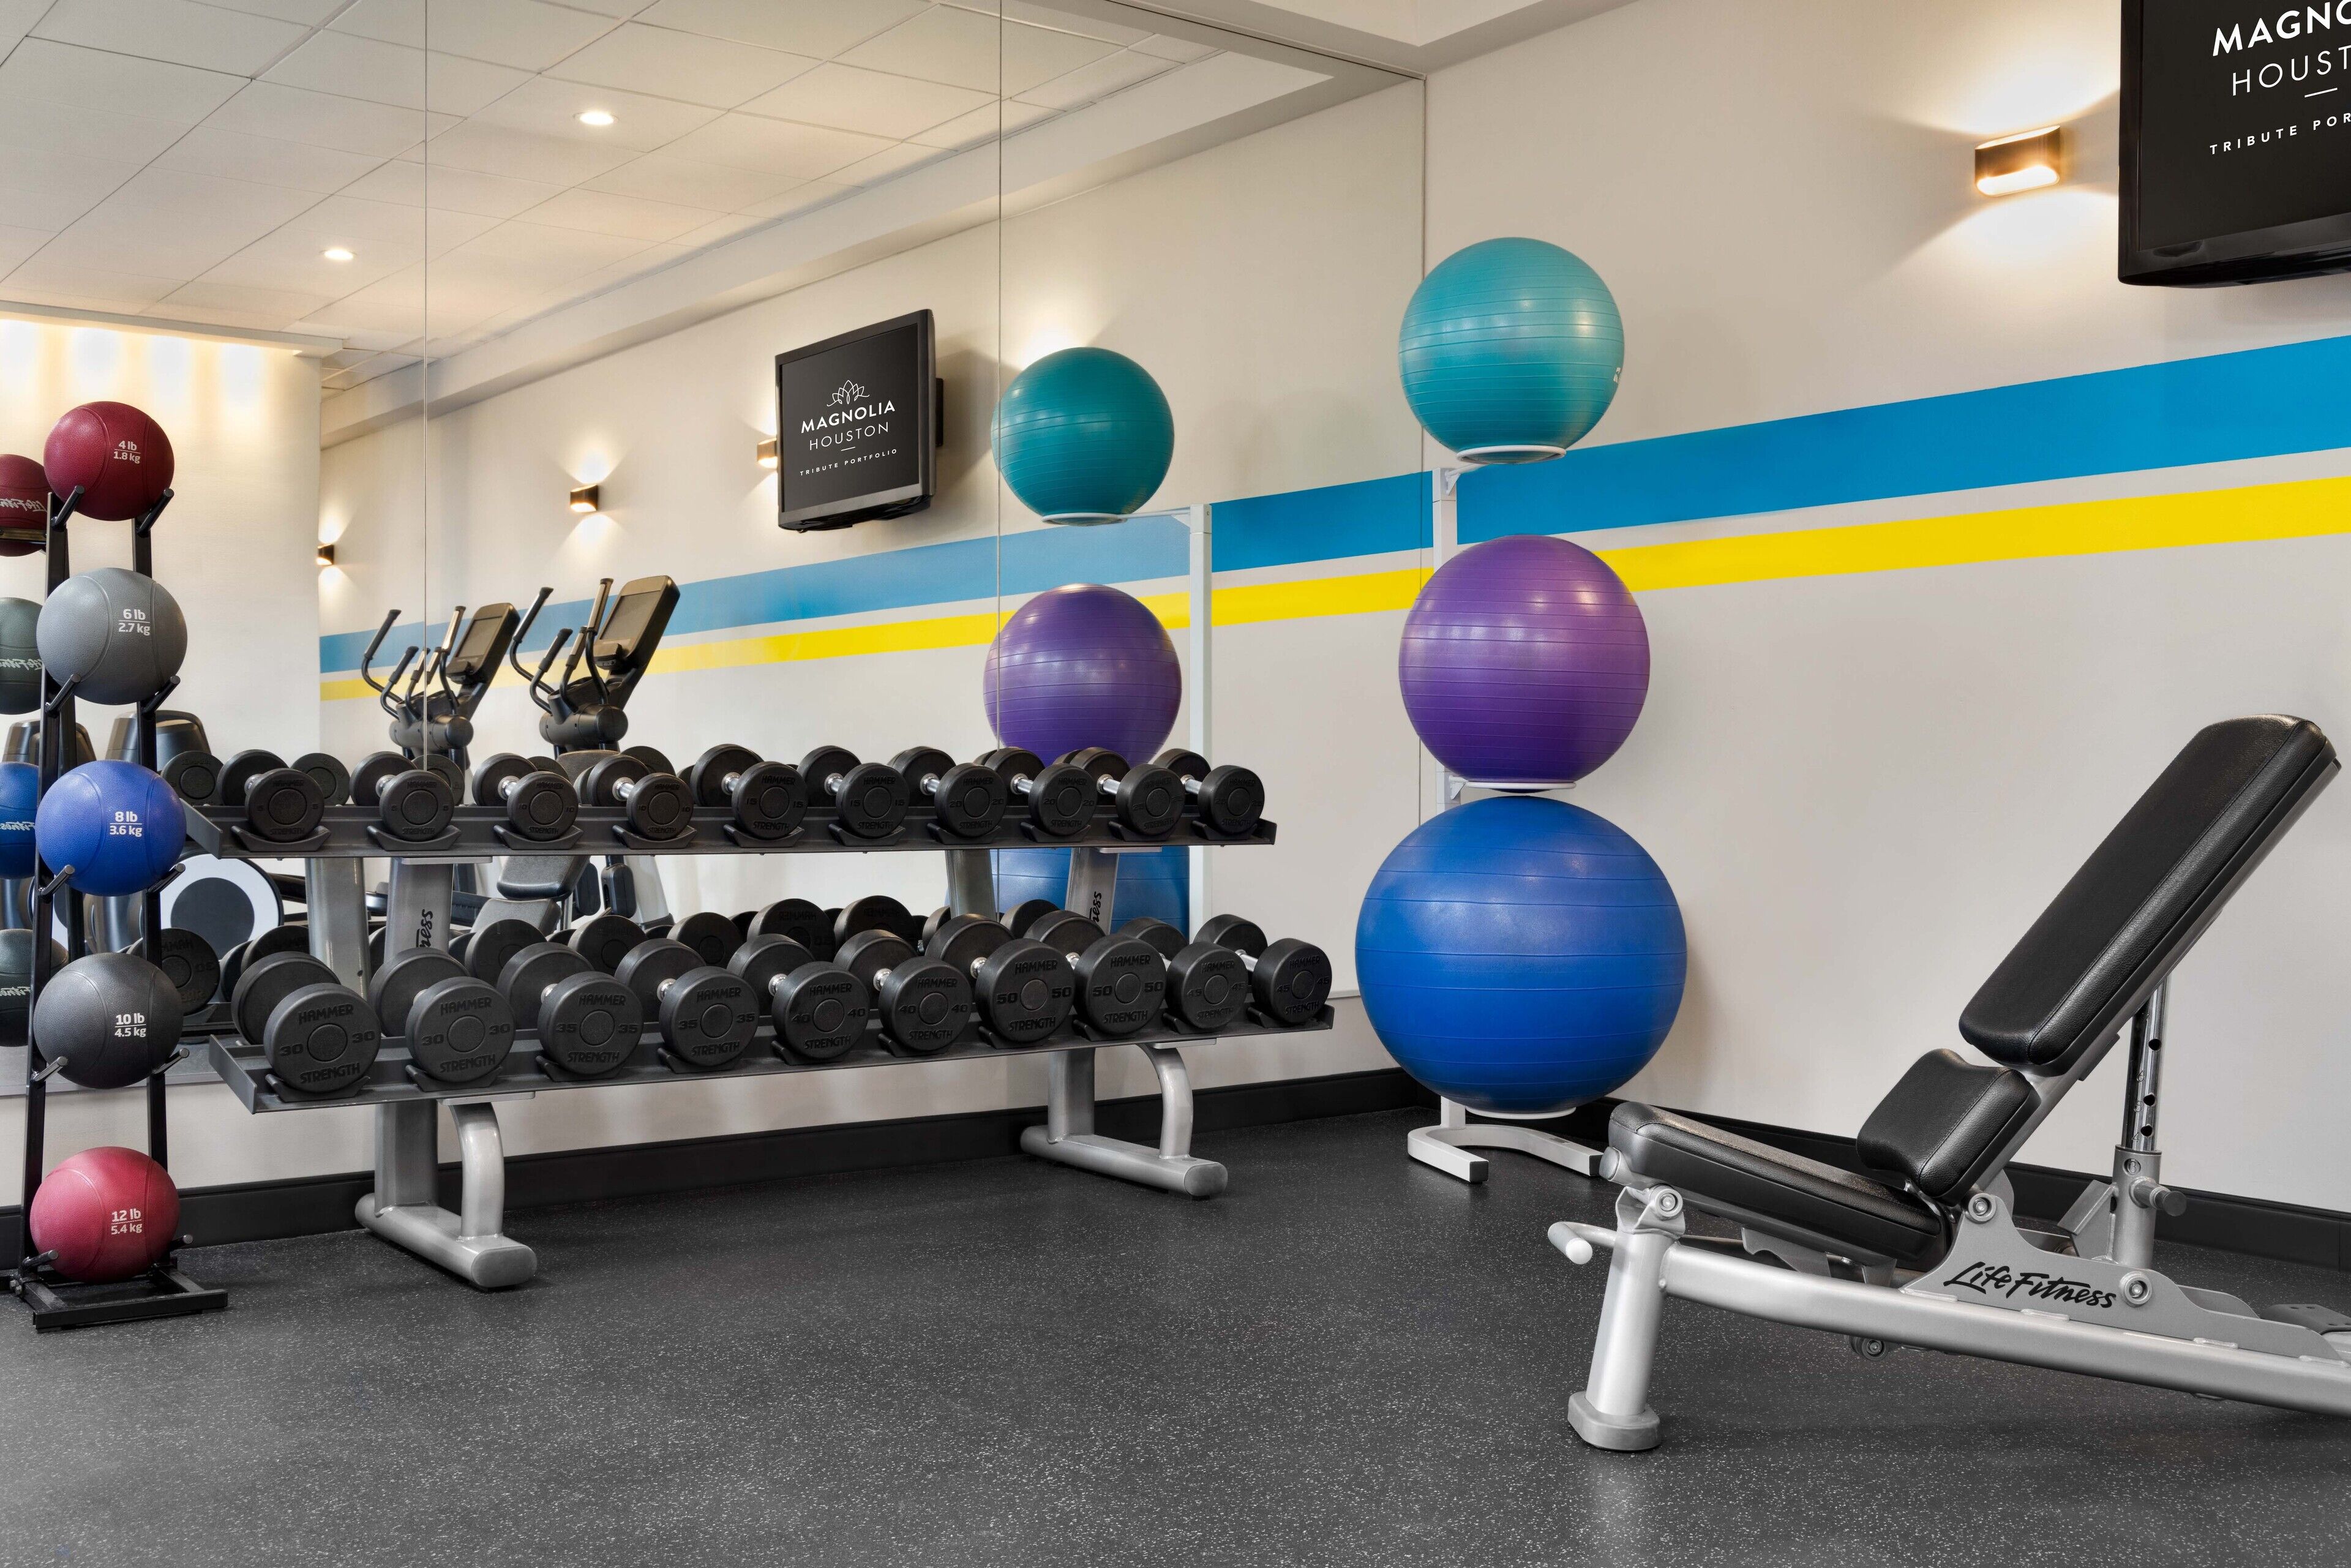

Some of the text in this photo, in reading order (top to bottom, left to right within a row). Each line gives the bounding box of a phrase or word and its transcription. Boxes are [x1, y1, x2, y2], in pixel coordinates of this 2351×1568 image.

[2233, 45, 2351, 96] HOUST
[2210, 112, 2351, 155] TRIBUTE POR
[801, 400, 896, 434] MAGNOLIA
[809, 421, 889, 451] HOUSTON
[118, 440, 137, 451] 4 lb
[113, 451, 141, 464] 1.8 kg
[800, 449, 898, 476] TRIBUTE PORTFOLIO
[123, 609, 146, 620] 6 lb
[118, 623, 151, 636] 2.7 kg
[762, 775, 796, 786] HAMMER
[115, 811, 138, 822] 8 lb
[109, 825, 143, 838] 3.6 kg
[752, 820, 790, 830] STRENGTH
[1089, 891, 1102, 923] ness
[416, 909, 433, 948] ness
[1015, 959, 1059, 975] HAMMER
[1110, 954, 1152, 968] HAMMER
[1201, 959, 1235, 974] HAMMER
[1289, 956, 1321, 972] HAMMER
[809, 983, 852, 996] HAMMER
[917, 978, 958, 989] HAMMER
[1092, 981, 1164, 996] 50 50
[1277, 977, 1329, 993] 45 45
[579, 994, 627, 1007] HAMMER
[696, 986, 742, 1002] HAMMER
[996, 986, 1073, 1004] 50 50
[440, 996, 492, 1016] HAMMER
[898, 1003, 969, 1015] 40 40
[1196, 1007, 1234, 1020] STRENGTH
[1284, 1001, 1319, 1015] STRENGTH
[116, 1013, 145, 1026] 10 lb
[298, 1003, 354, 1026] HAMMER
[678, 1012, 756, 1029] 35 35
[791, 1008, 866, 1024] 40 40
[1103, 1010, 1149, 1024] STRENGTH
[555, 1023, 639, 1035] 35 35
[1008, 1016, 1057, 1032] STRENGTH
[114, 1027, 146, 1039] 4.5 kg
[421, 1023, 511, 1046] 30 30
[909, 1030, 953, 1041] STRENGTH
[279, 1030, 375, 1056] 30 30
[691, 1041, 740, 1057] STRENGTH
[804, 1035, 852, 1050] STRENGTH
[439, 1054, 497, 1074] STRENGTH
[567, 1051, 620, 1063] STRENGTH
[298, 1062, 361, 1084] STRENGTH
[2137, 1070, 2145, 1082] 6
[111, 1209, 141, 1222] 12 lb
[111, 1221, 143, 1234] 5.4 kg
[1943, 1261, 2117, 1308] Life Fitness
